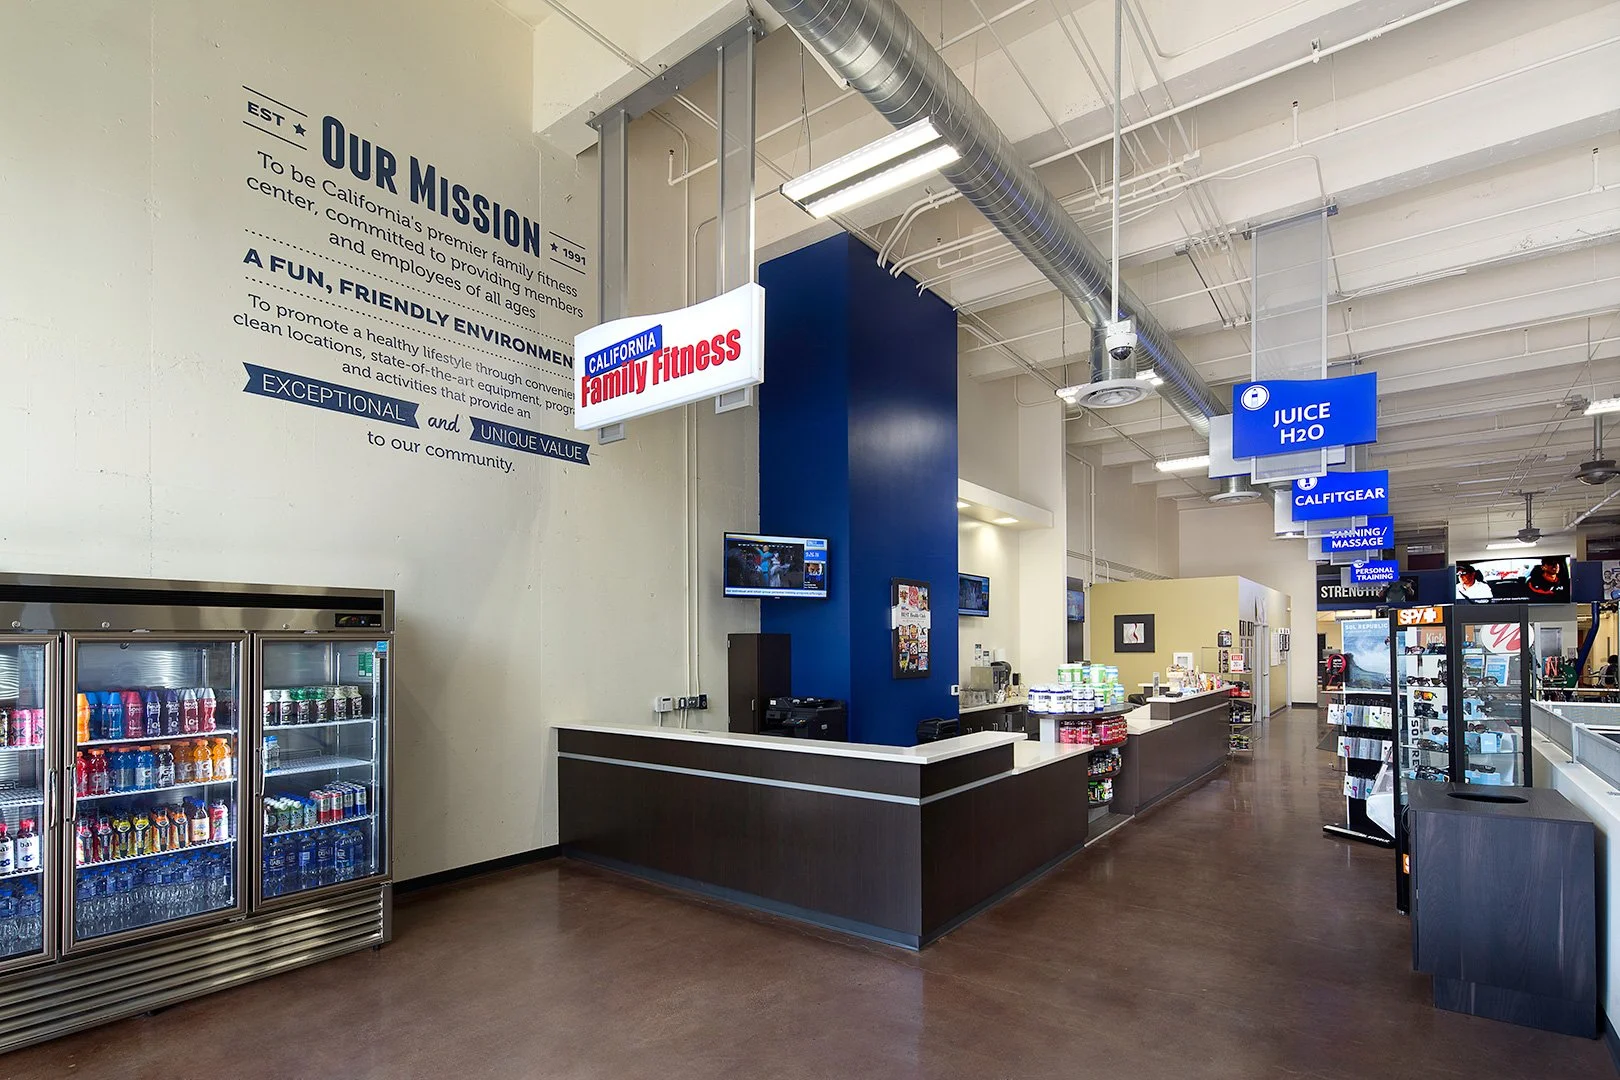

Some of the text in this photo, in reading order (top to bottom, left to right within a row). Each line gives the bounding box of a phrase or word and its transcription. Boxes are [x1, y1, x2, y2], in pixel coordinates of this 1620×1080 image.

[248, 101, 285, 126] EST
[322, 115, 539, 258] OUR MISSION
[257, 150, 577, 297] To be California's premier family fitness
[246, 177, 583, 318] center, committed to providing members
[562, 248, 585, 265] 1991
[329, 233, 535, 318] and employees of all ages
[243, 248, 574, 369] A FUN, FRIENDLY ENVIRONMEN
[233, 312, 284, 336] clean
[287, 325, 365, 359] locations,
[370, 351, 474, 387] state-of-the-art
[477, 381, 542, 407] equipment,
[248, 293, 270, 311] To
[276, 305, 348, 334] promote
[353, 328, 362, 338] a
[366, 328, 419, 357] healthy
[422, 345, 471, 370] lifestyle
[475, 362, 522, 385] through
[589, 332, 656, 373] CALIFORNIA
[581, 329, 741, 408] Family Fitness
[342, 363, 531, 419] and activities that provide an
[263, 374, 582, 461] EXCEPTIONAL and UNIQUE VALUE
[1273, 402, 1331, 428] JUICE
[1280, 424, 1324, 444] H2O
[367, 431, 514, 473] to our community.
[1295, 488, 1385, 506] CALFITGEAR
[1332, 537, 1383, 548] MASSAGE
[1355, 567, 1394, 575] PERSONAL
[1356, 573, 1394, 581] TRAINING
[1399, 608, 1423, 625] SPY
